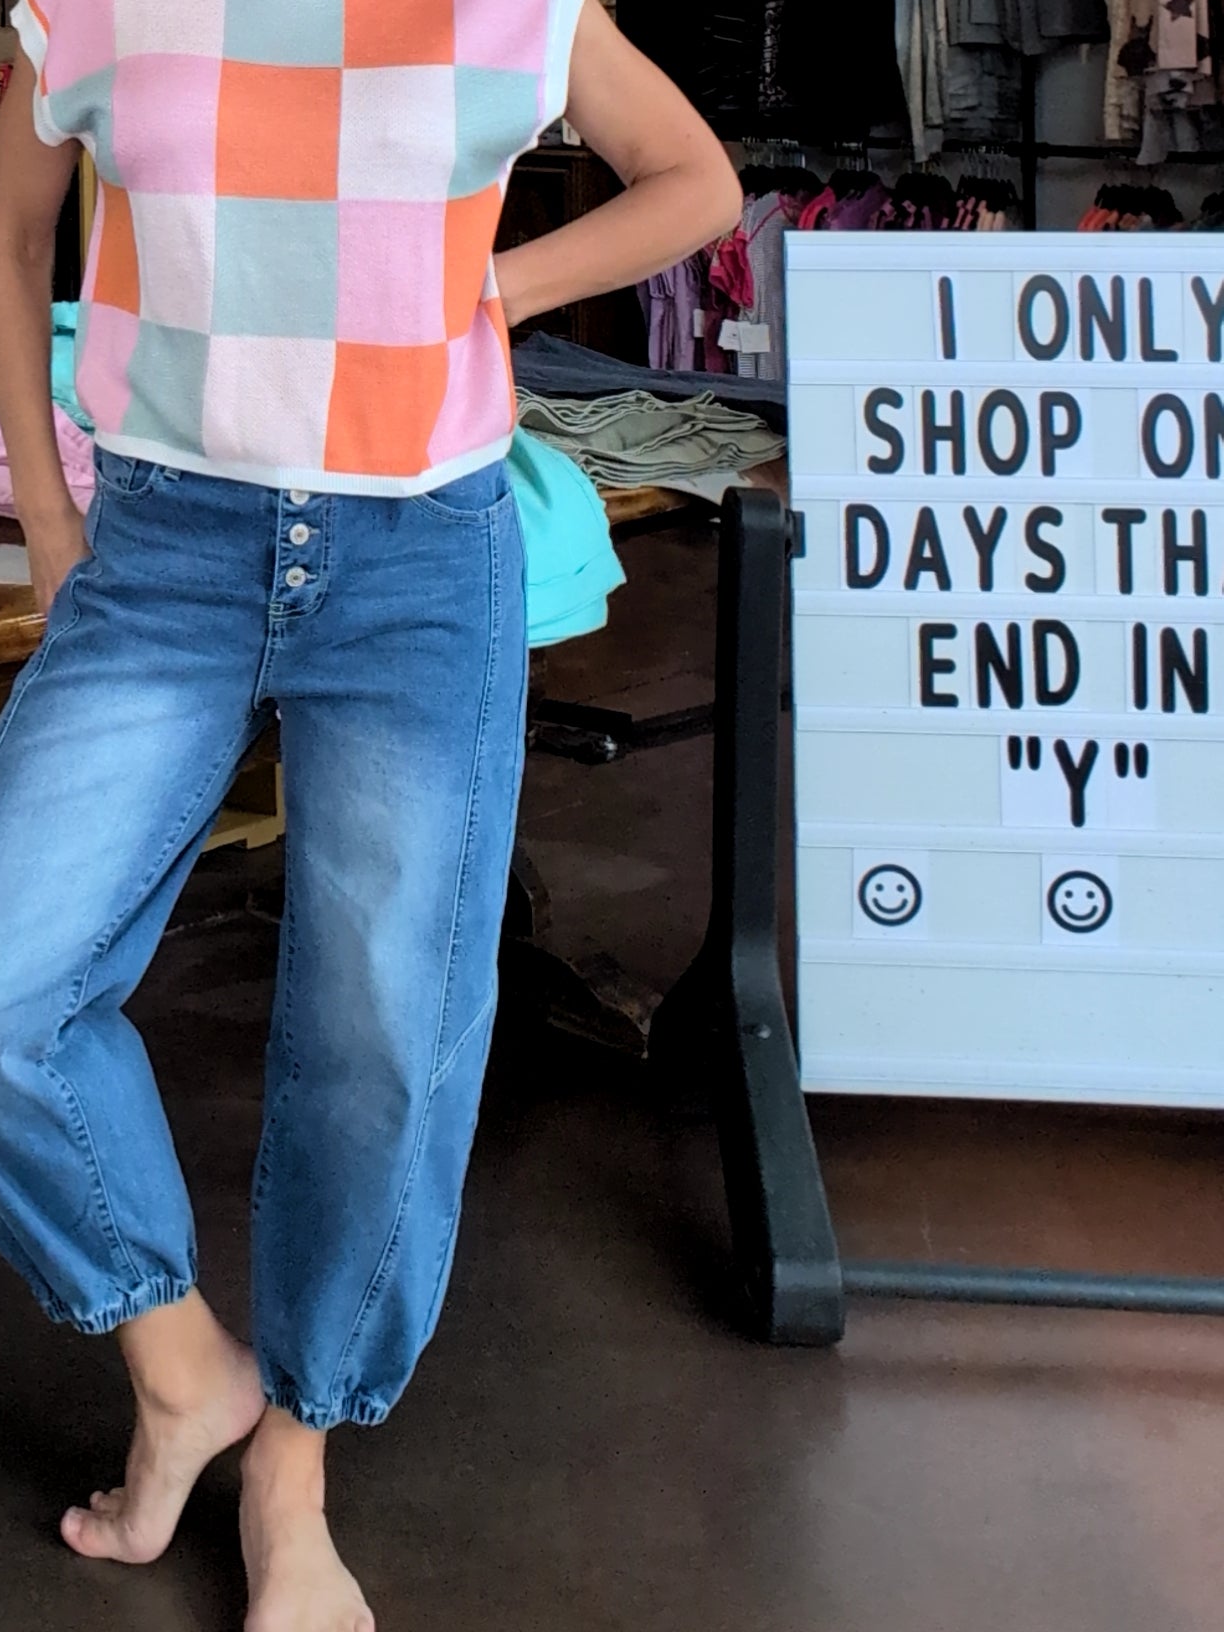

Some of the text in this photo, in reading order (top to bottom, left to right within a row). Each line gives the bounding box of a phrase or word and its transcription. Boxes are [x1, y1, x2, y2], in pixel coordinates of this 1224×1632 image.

[938, 275, 1224, 363] I ONLY
[863, 388, 1082, 476] SHOP
[844, 504, 1224, 597] DAYS TH
[918, 620, 1209, 714] END IN
[1006, 737, 1150, 828] "Y"
